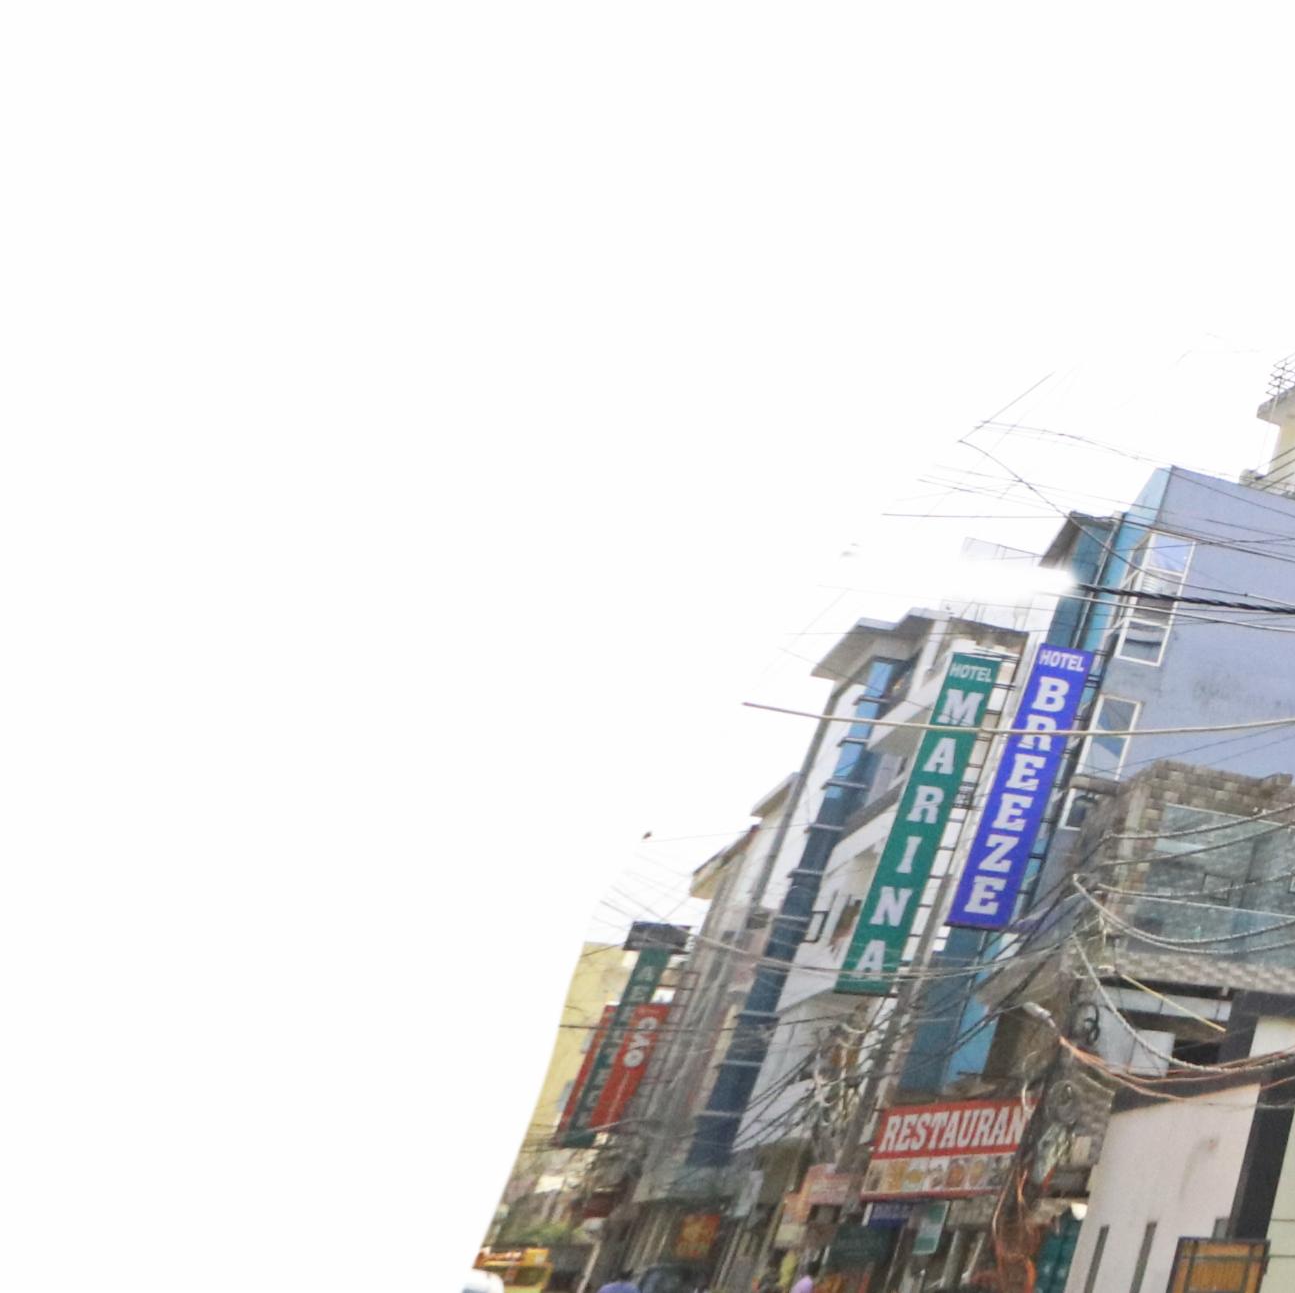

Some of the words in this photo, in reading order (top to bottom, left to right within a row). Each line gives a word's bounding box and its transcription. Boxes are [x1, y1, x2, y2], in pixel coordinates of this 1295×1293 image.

[949, 662, 993, 683] HOTEL
[1037, 649, 1085, 673] HOTEL
[963, 676, 1070, 915] BREEZE
[852, 689, 985, 981] MARINA
[878, 1105, 1031, 1153] RESTAURAN
